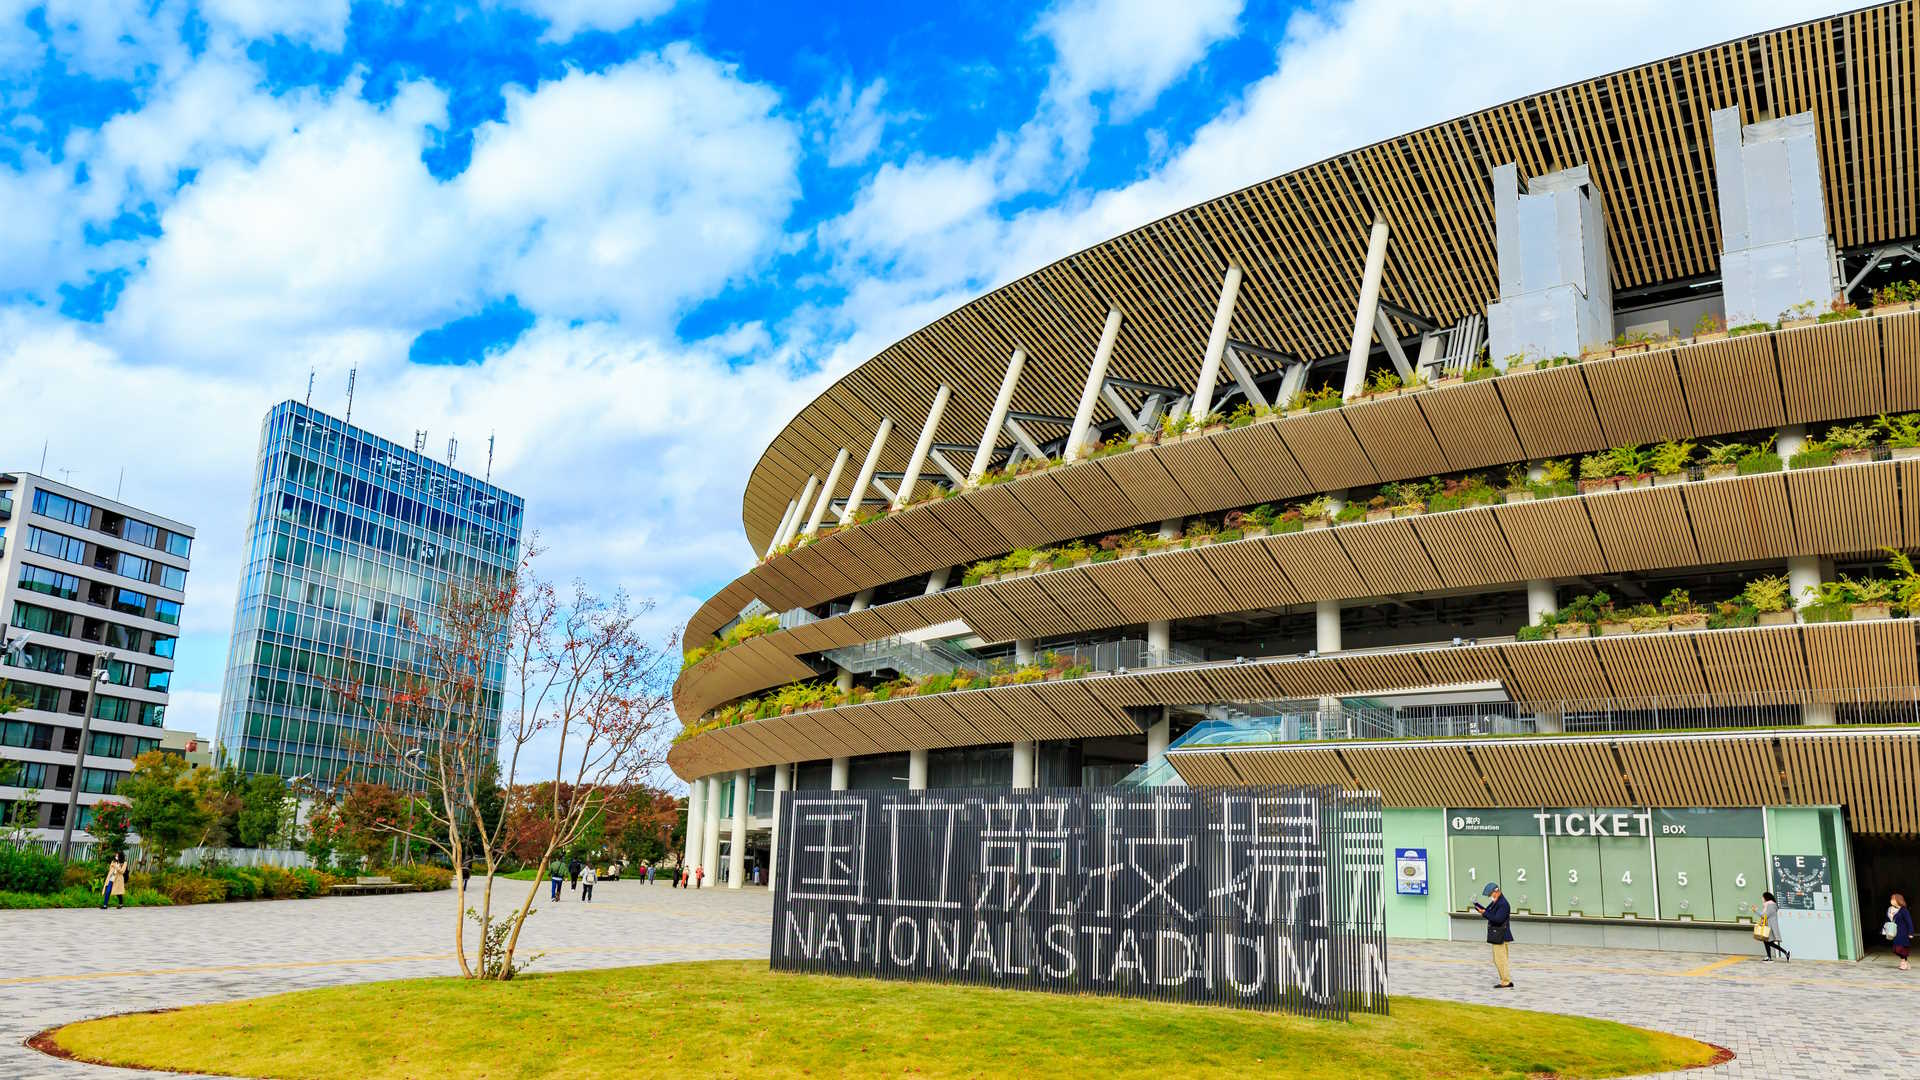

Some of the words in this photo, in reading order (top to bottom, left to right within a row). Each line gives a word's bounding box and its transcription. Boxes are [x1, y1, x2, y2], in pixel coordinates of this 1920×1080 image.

[1533, 813, 1649, 837] TICKET
[1662, 825, 1686, 834] BOX
[1795, 856, 1805, 867] E
[1468, 867, 1476, 880] 1
[1517, 868, 1527, 881] 2
[1568, 869, 1578, 883] 3
[1622, 871, 1632, 884] 4
[1678, 872, 1688, 886] 5
[1735, 873, 1746, 887] 6
[784, 910, 1029, 976] NATIONAL
[1044, 923, 1329, 1003] STADIUM
